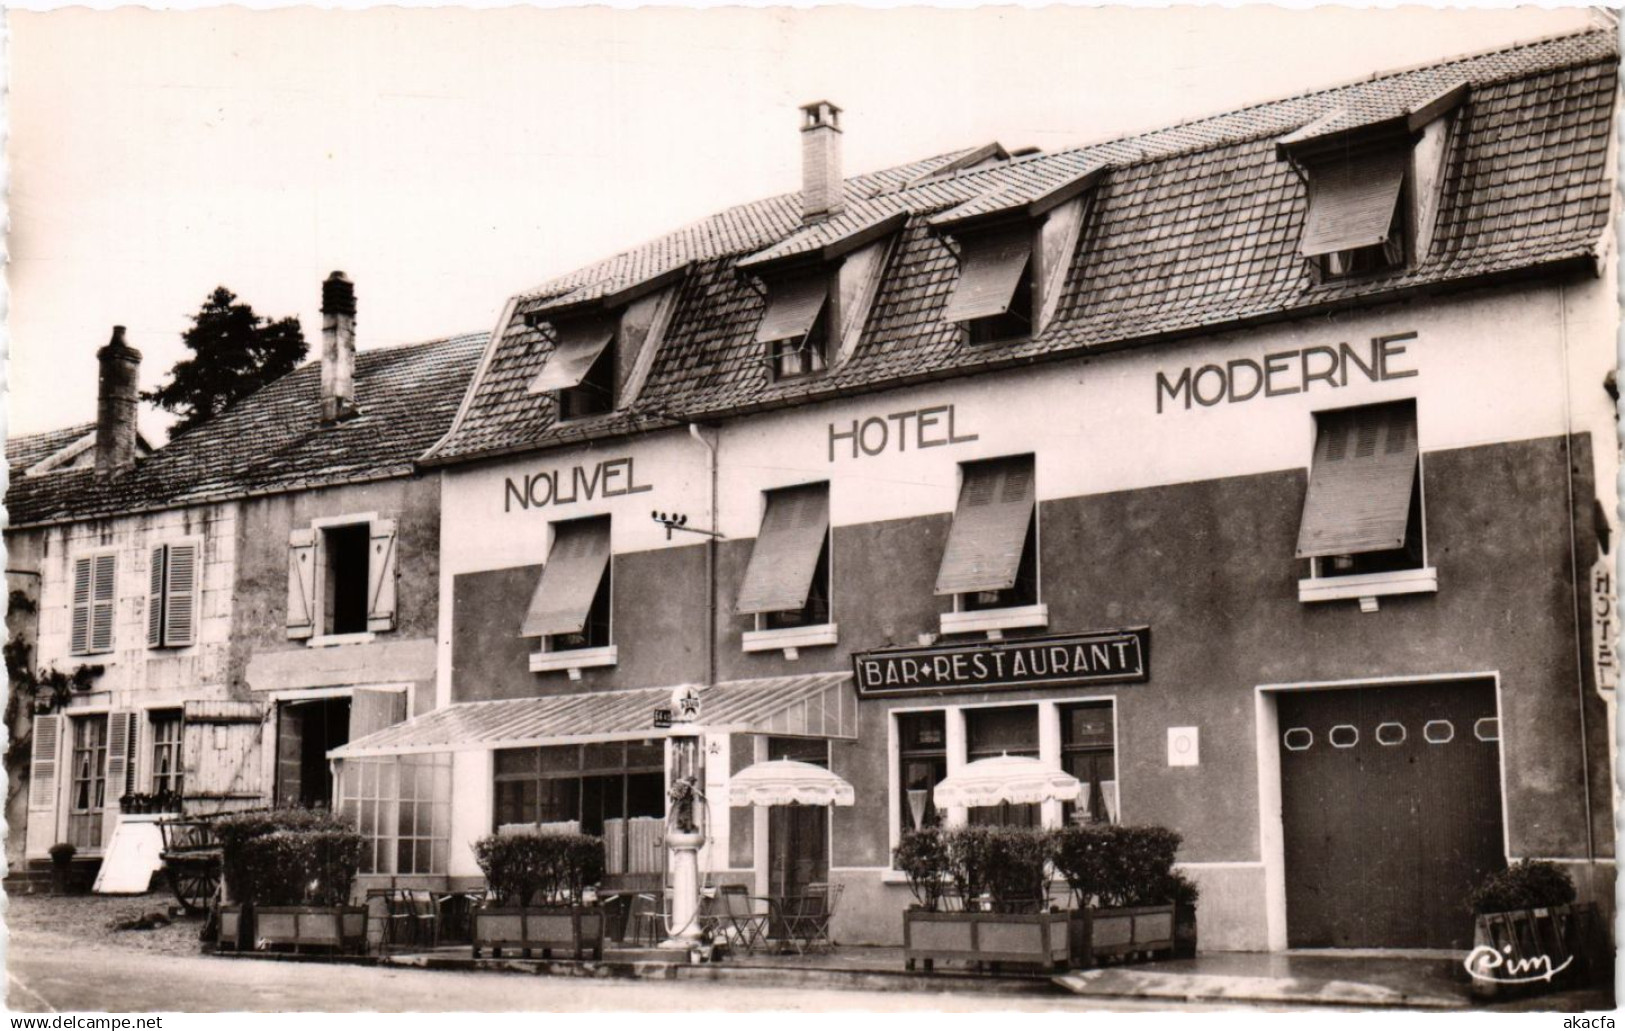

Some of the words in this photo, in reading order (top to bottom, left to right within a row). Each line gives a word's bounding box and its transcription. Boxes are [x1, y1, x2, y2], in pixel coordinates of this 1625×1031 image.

[505, 457, 653, 513] NOUVEL
[829, 404, 979, 462] HOTEL
[1156, 331, 1418, 414] MODERNE
[865, 659, 920, 686] BAR
[934, 642, 1130, 682] RESTAURANT
